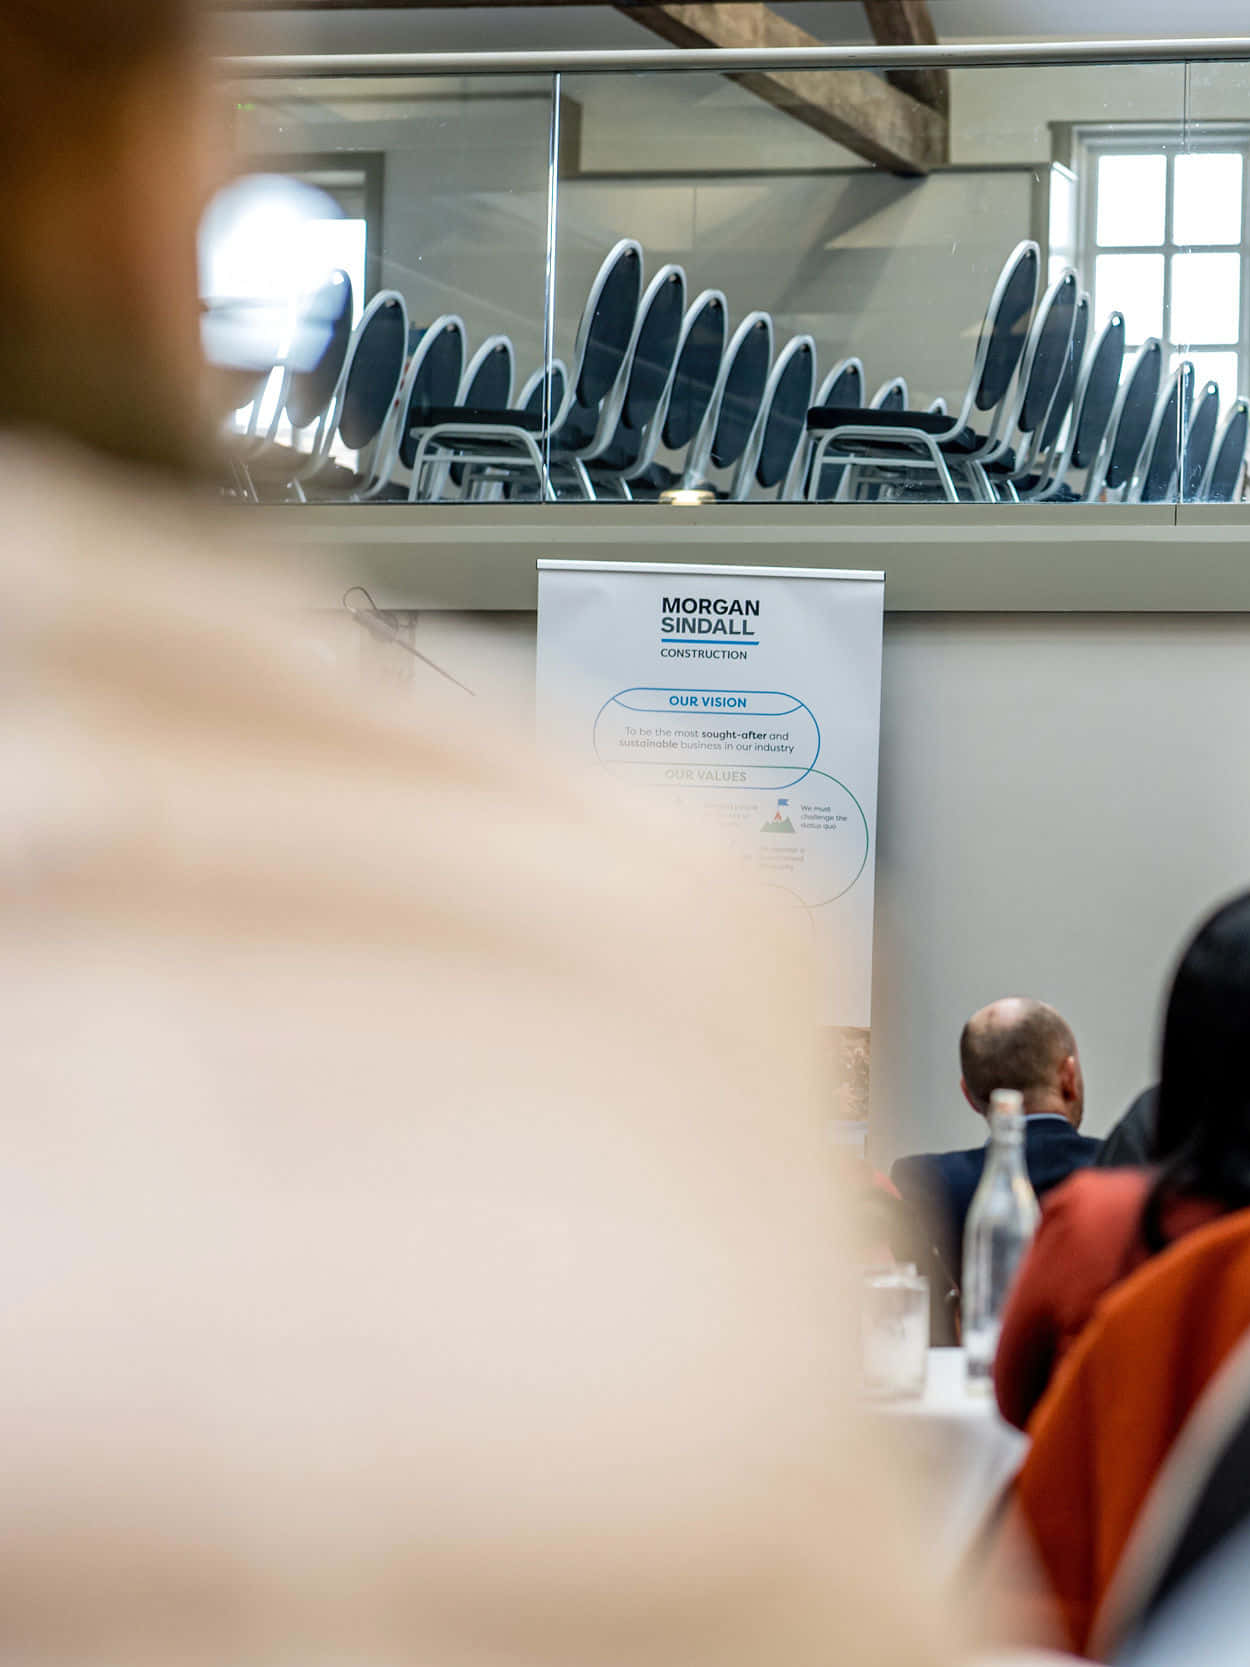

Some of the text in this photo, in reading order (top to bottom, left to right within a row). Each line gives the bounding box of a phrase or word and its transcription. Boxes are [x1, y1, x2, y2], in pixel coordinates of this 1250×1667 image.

[662, 597, 760, 616] MORGAN
[661, 616, 756, 635] SINDALL
[660, 648, 748, 660] CONSTRUCTION
[669, 695, 747, 708] OUR VISION
[639, 727, 650, 737] be
[655, 728, 672, 738] the
[674, 729, 699, 739] most
[702, 730, 767, 741] sought-after
[769, 732, 789, 741] and
[618, 738, 795, 754] sustainable business in our industry
[665, 769, 747, 782] OUR VALUES
